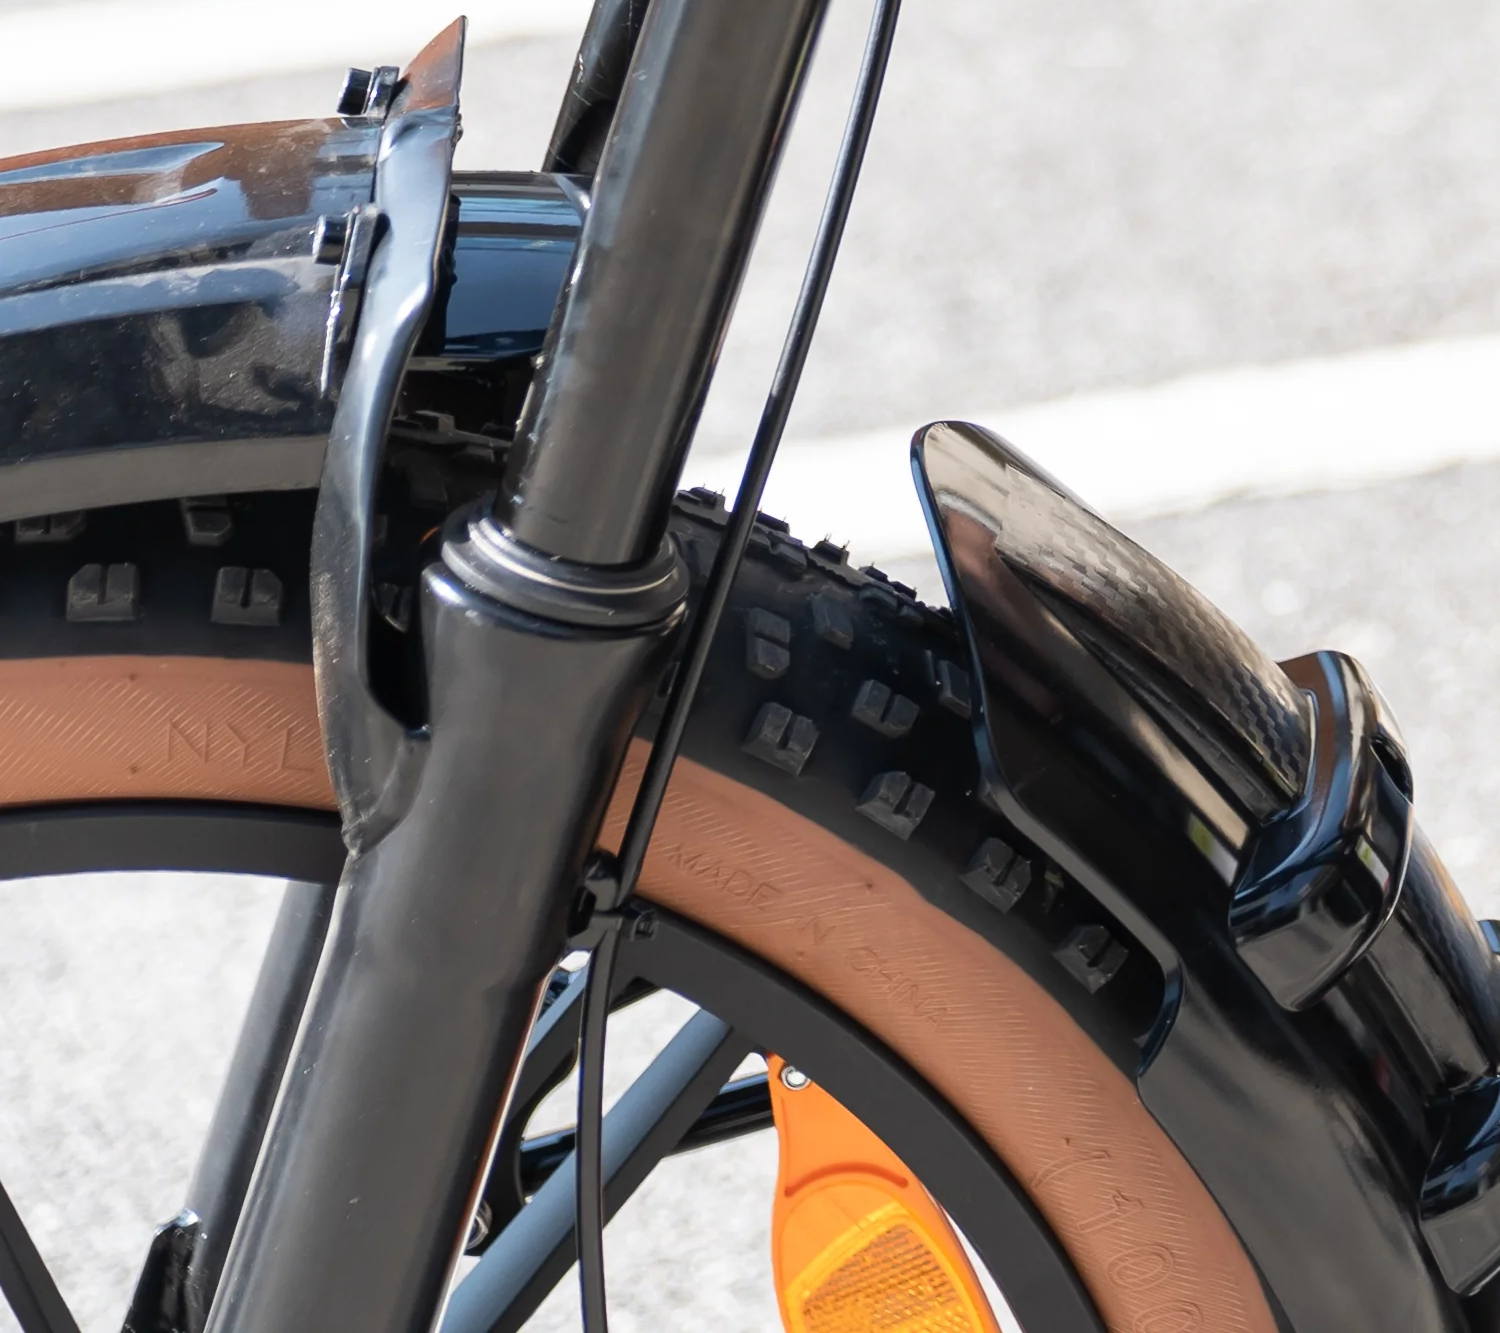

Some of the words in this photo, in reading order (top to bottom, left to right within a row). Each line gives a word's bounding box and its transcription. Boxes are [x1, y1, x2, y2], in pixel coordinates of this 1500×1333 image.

[167, 720, 315, 774] NYL
[667, 843, 786, 913] MADE
[847, 945, 949, 1033] CHINA
